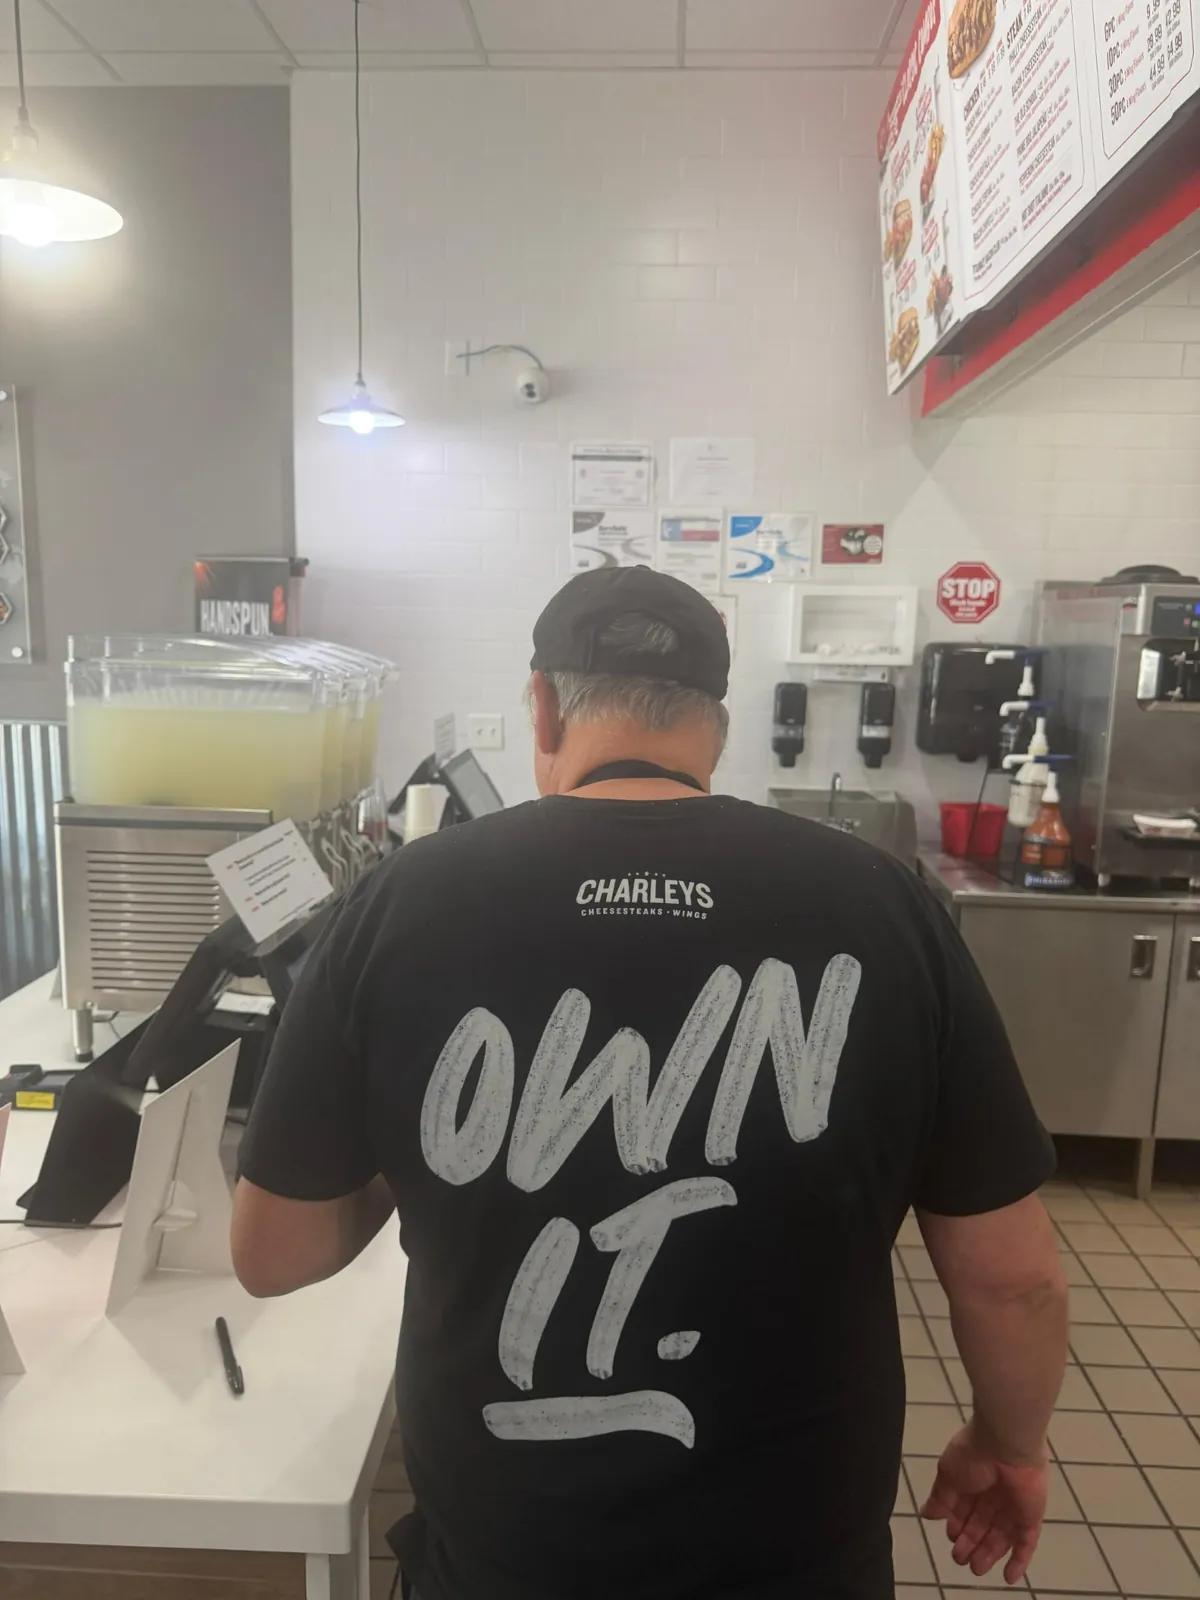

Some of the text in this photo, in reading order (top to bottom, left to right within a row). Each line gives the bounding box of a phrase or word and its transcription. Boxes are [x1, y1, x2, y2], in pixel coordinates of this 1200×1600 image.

[1006, 10, 1023, 49] STEAK
[1106, 42, 1121, 70] 10PC
[1108, 68, 1124, 98] 30PC
[1110, 97, 1126, 126] 50PC
[941, 577, 996, 600] STOP
[576, 877, 715, 910] CHARLEYS
[580, 907, 708, 921] CHEESESTEAKS WINGS
[419, 952, 863, 1194] OWN
[497, 1175, 738, 1391] IT.
